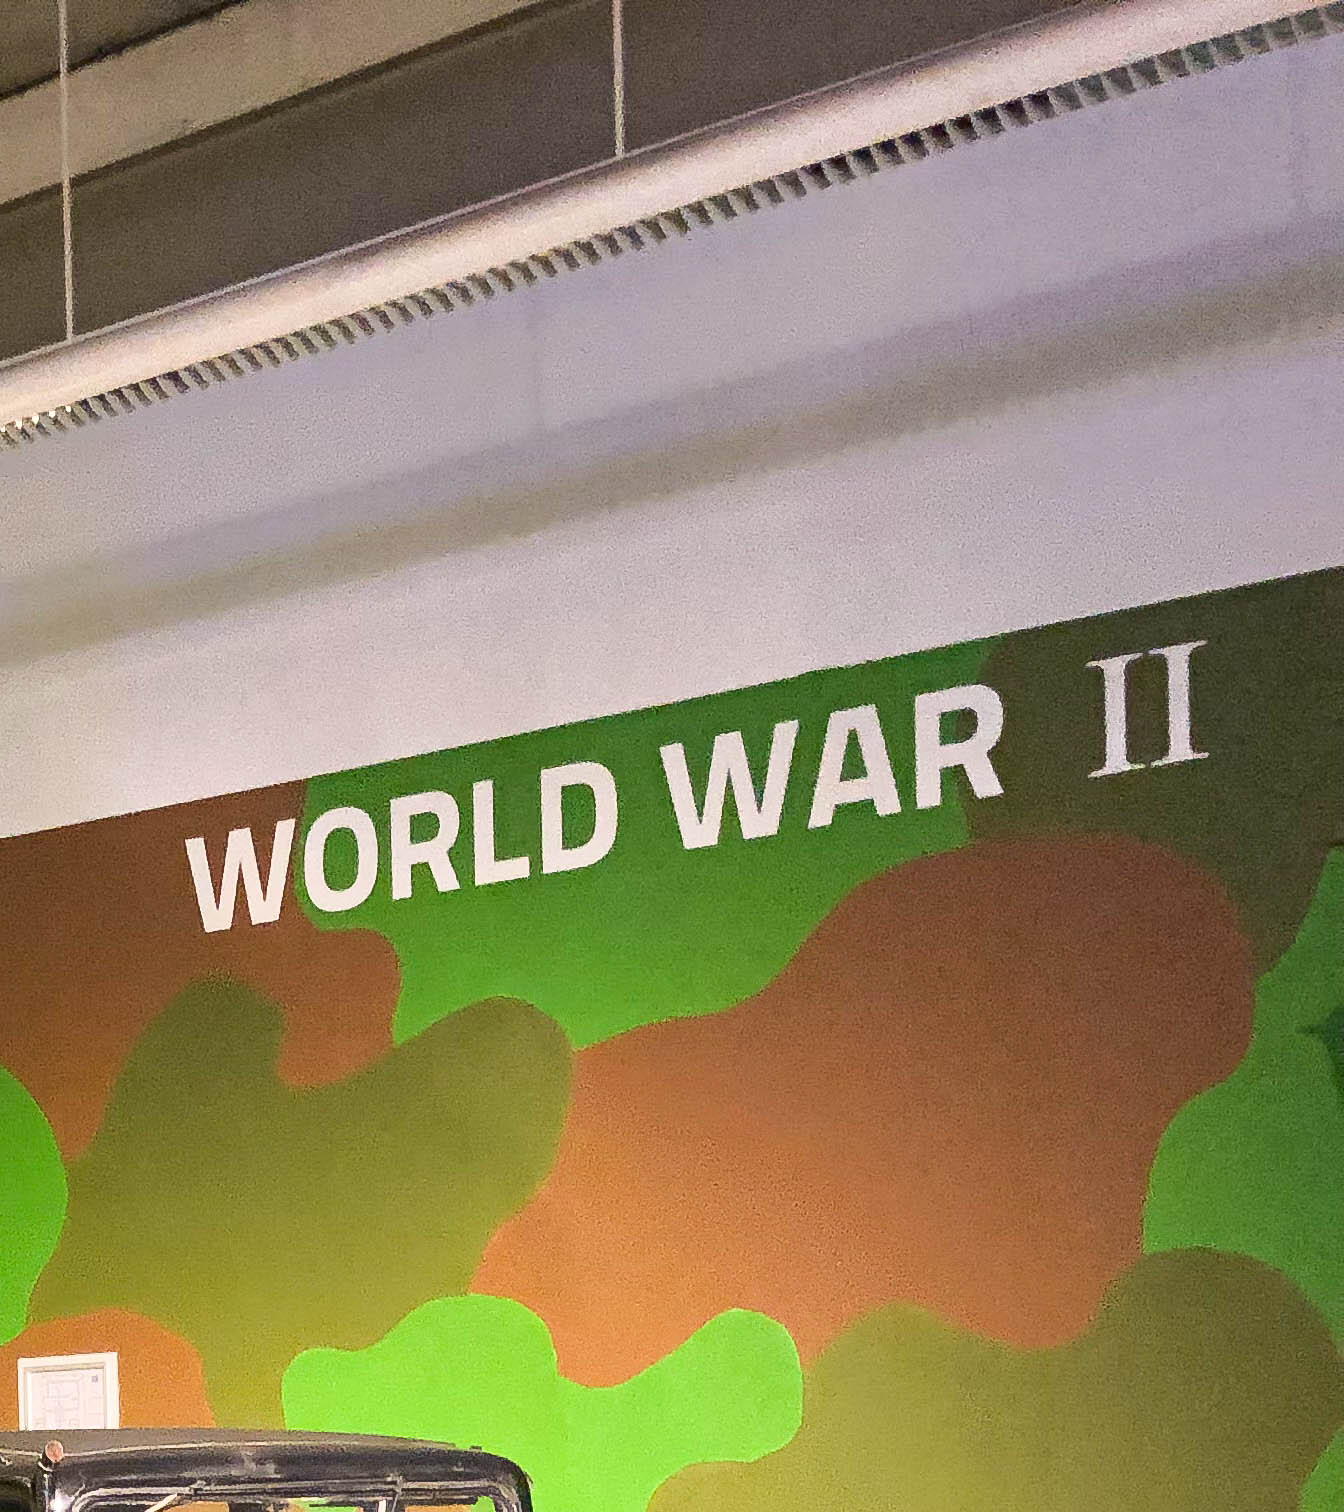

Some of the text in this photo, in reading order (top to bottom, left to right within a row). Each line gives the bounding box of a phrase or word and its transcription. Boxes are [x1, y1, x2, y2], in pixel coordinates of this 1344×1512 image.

[184, 638, 1209, 935] WORLD WAR II
